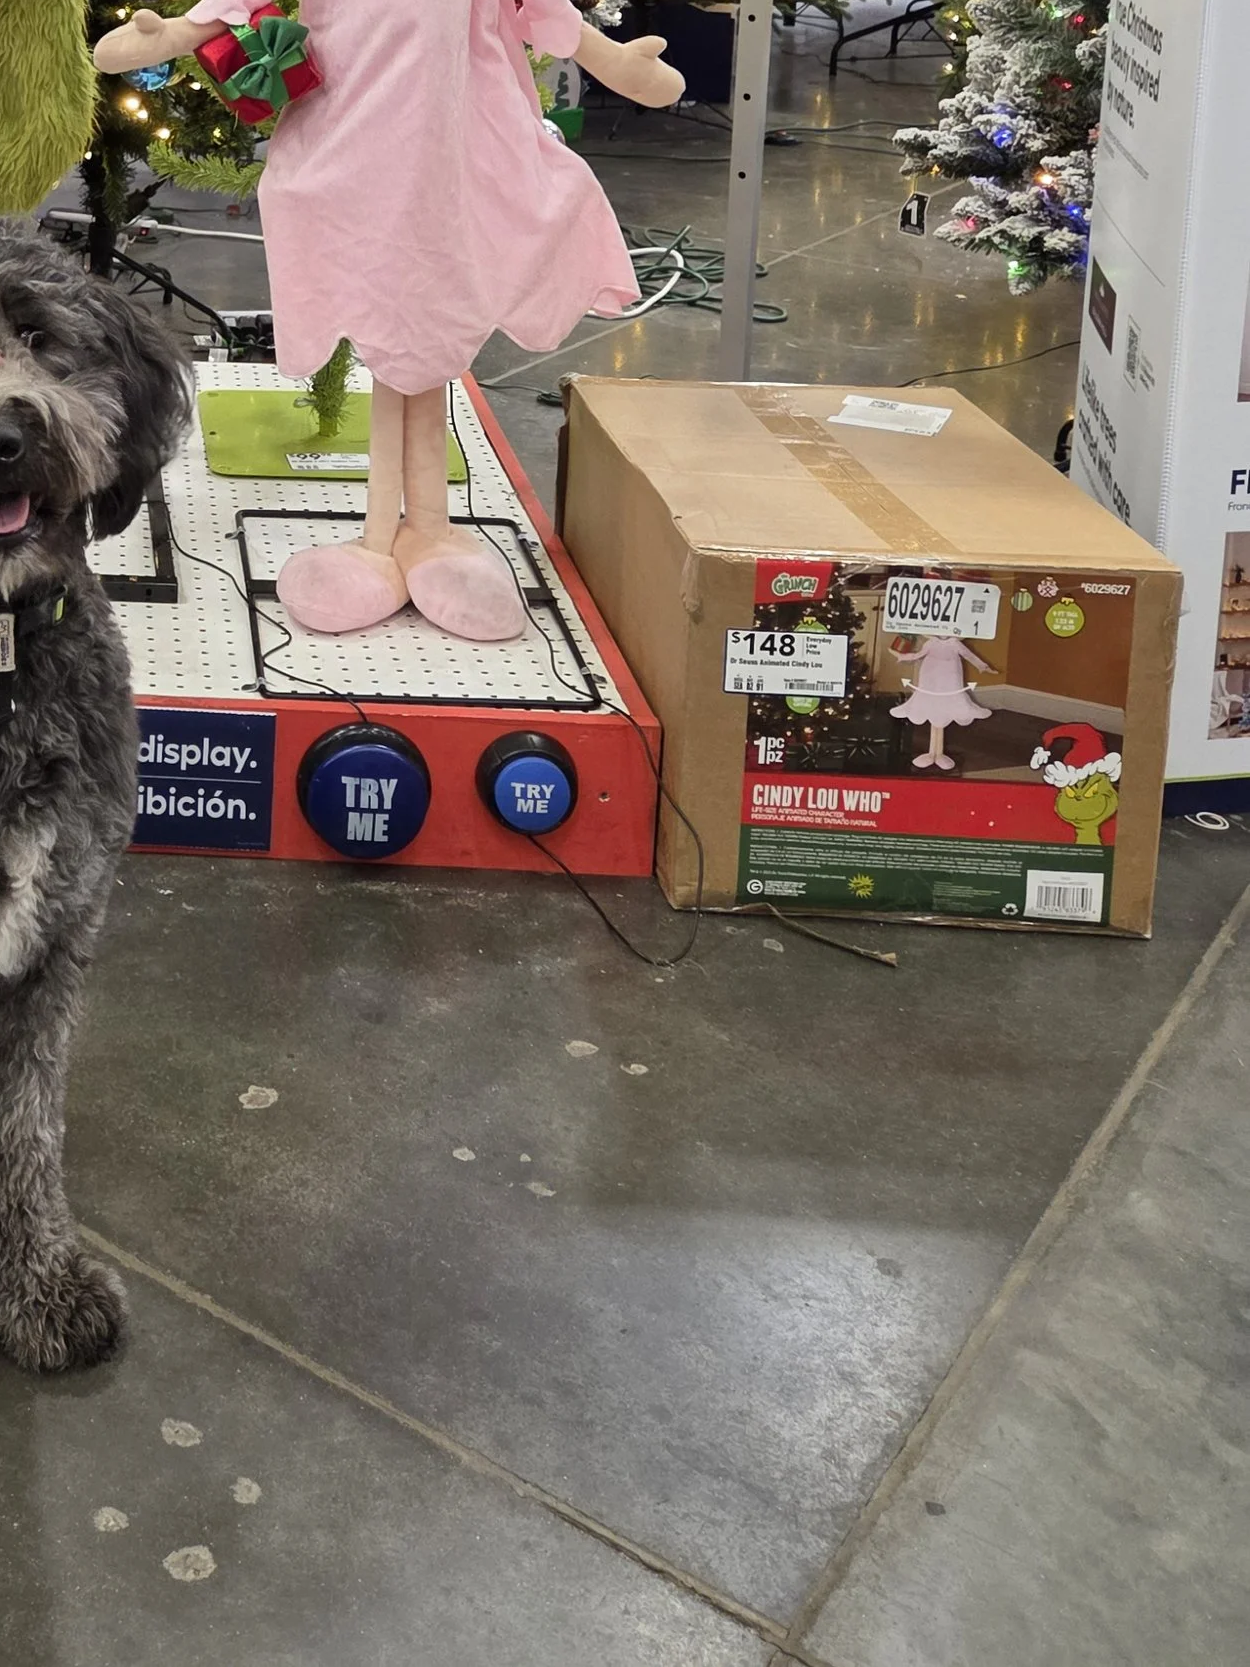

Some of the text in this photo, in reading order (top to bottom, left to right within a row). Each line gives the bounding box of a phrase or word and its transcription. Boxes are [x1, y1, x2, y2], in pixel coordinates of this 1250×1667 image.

[1127, 0, 1163, 59] Christmas
[1111, 35, 1161, 105] beauty inspired
[1107, 76, 1135, 131] by nature.
[1101, 403, 1117, 454] trees
[1098, 448, 1112, 497] with
[1230, 469, 1250, 495] F
[773, 577, 817, 595] GRINCH
[1081, 583, 1131, 595] #6029627
[887, 582, 965, 623] 6029627
[973, 621, 979, 635] 1
[731, 632, 795, 656] $148
[138, 734, 257, 773] display.
[753, 736, 785, 765] 1 pc
[767, 751, 783, 764] pz
[341, 774, 400, 811] TRY
[510, 782, 556, 799] TRY
[752, 784, 804, 807] CINDY
[807, 787, 838, 810] LOU
[516, 799, 549, 814] ME
[786, 815, 814, 823] ANIMADO
[347, 813, 389, 843] ME
